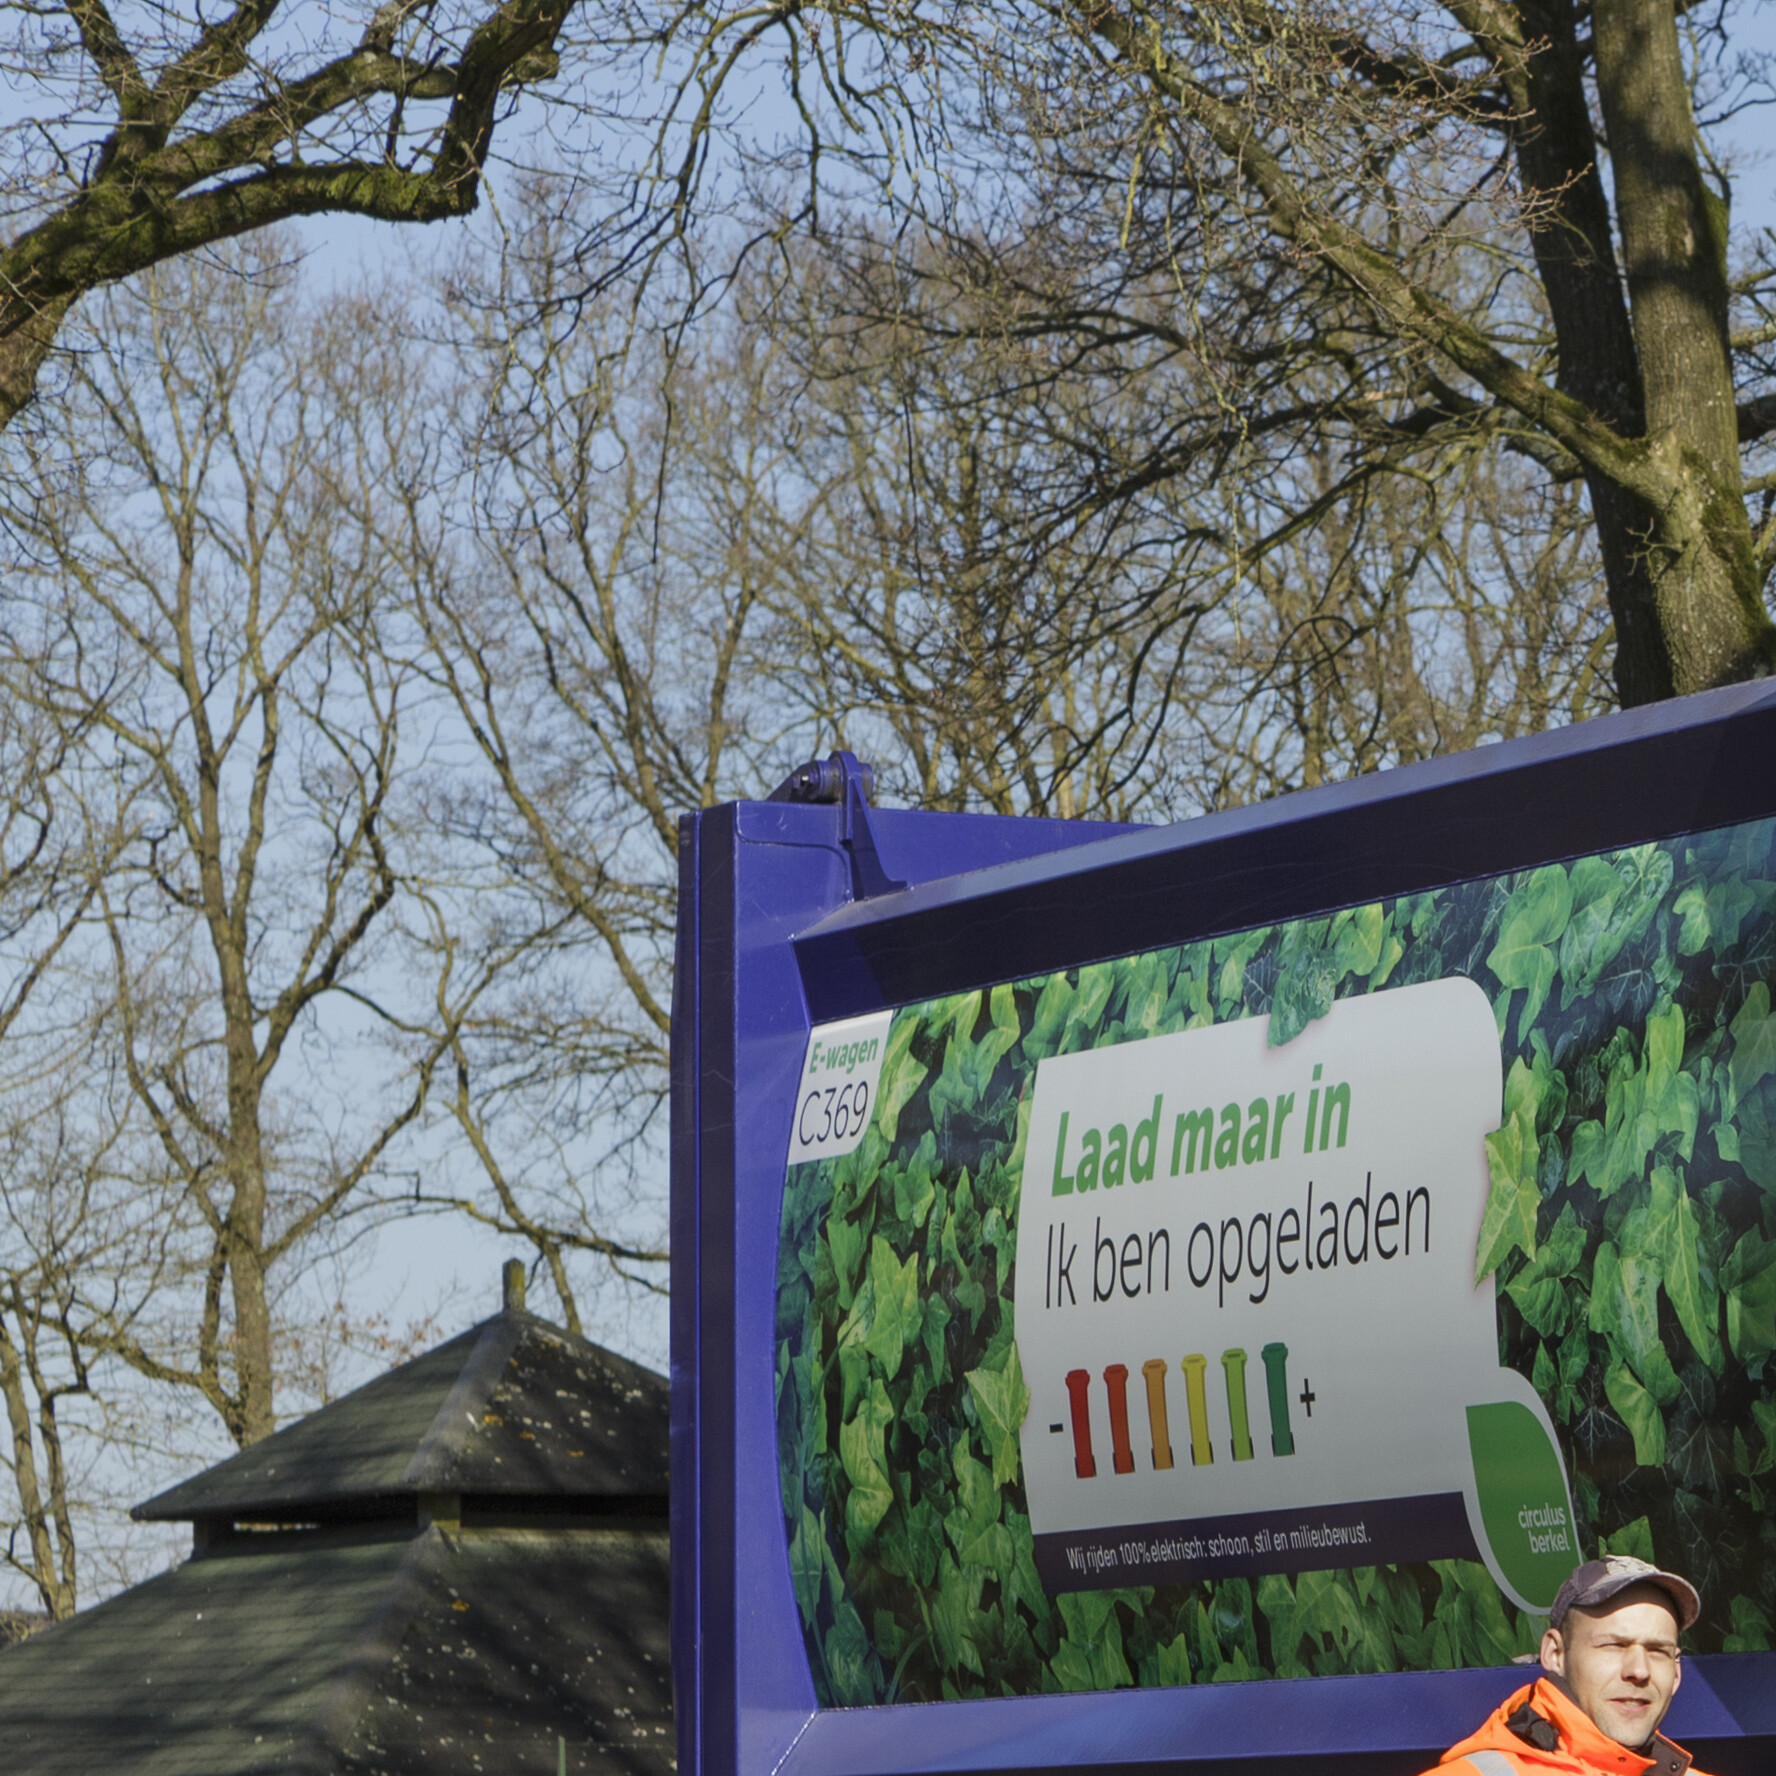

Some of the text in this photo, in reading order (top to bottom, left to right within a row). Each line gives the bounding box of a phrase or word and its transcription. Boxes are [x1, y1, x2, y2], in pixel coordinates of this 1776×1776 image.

[808, 1037, 879, 1074] E-wagen
[799, 1080, 868, 1146] C369
[1051, 1063, 1351, 1197] Laad maar in
[1046, 1171, 1430, 1309] Ik ben opgeladen
[1518, 1502, 1566, 1529] circulus
[1066, 1546, 1087, 1575] Wij
[1087, 1545, 1118, 1574] rijden
[1208, 1533, 1254, 1557] schoon,
[1254, 1528, 1272, 1553] stil
[1273, 1532, 1289, 1551] en
[1528, 1527, 1570, 1554] berkel
